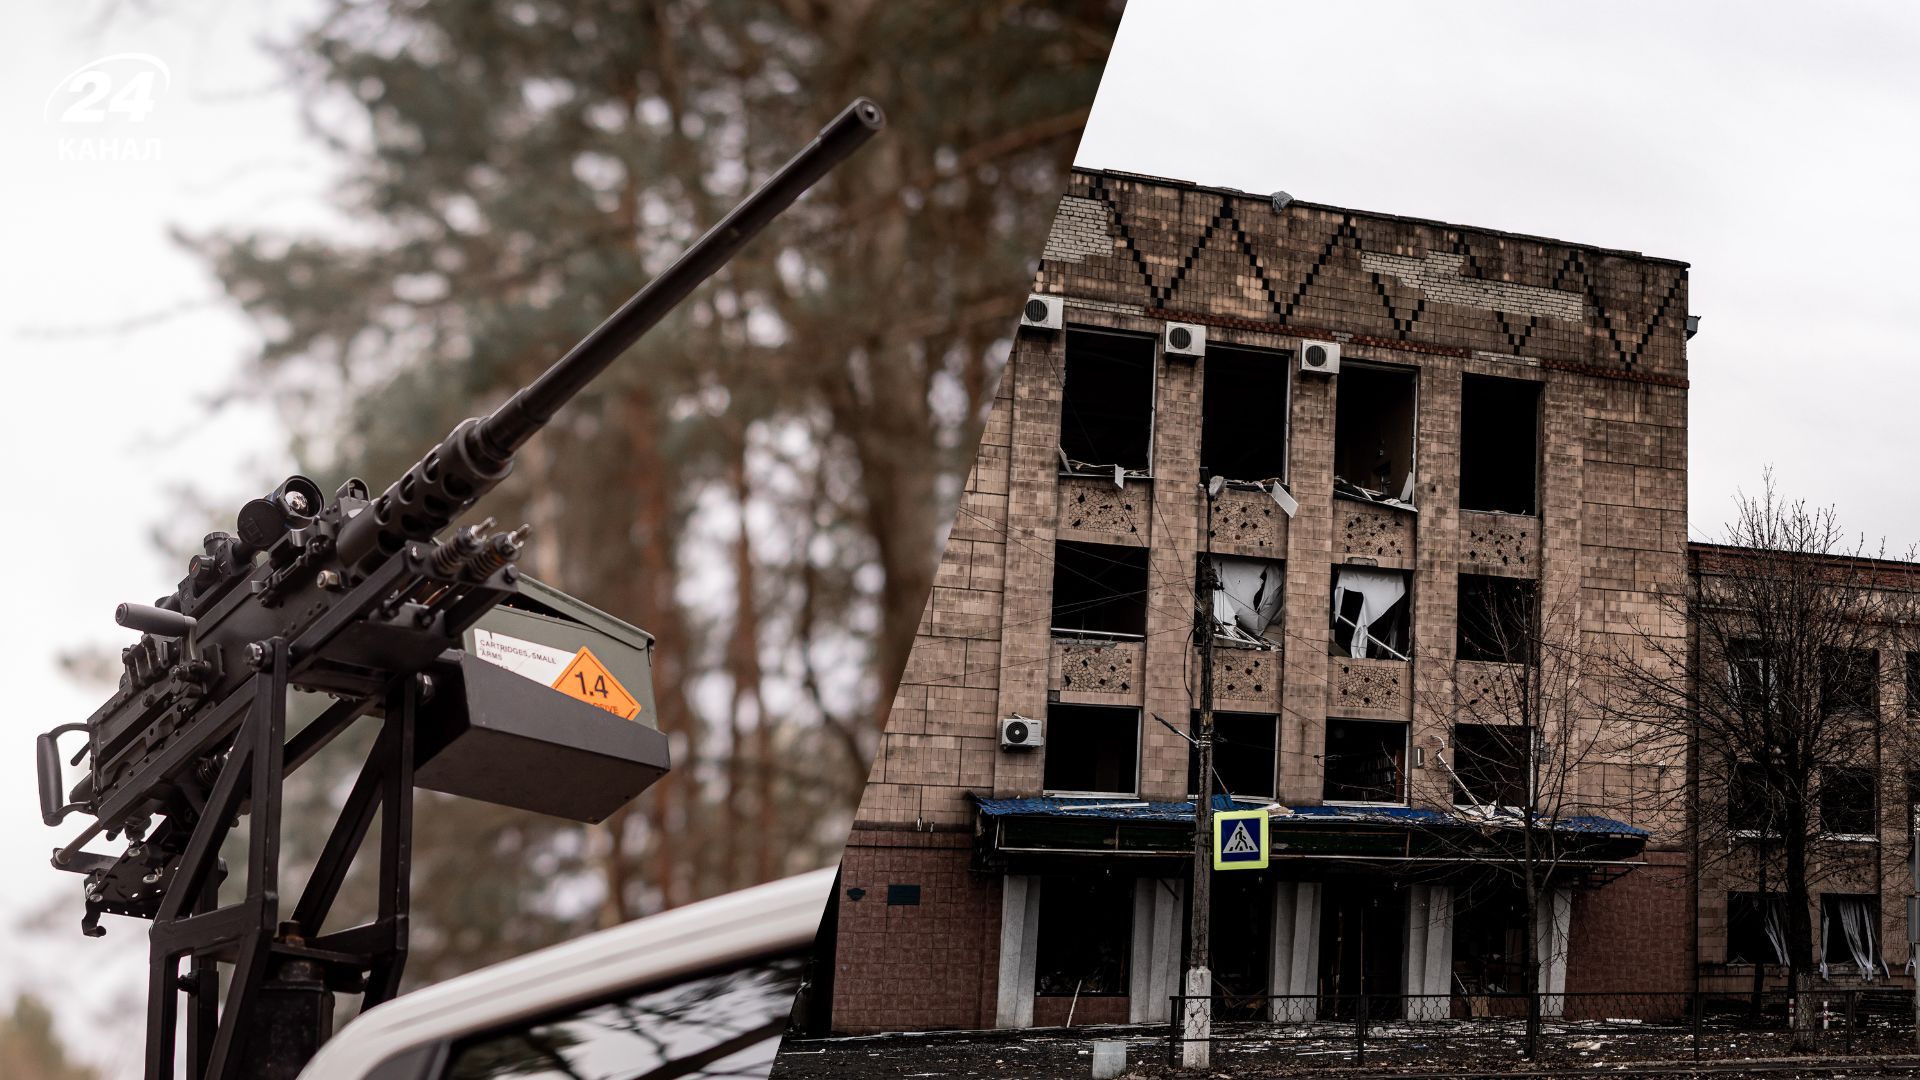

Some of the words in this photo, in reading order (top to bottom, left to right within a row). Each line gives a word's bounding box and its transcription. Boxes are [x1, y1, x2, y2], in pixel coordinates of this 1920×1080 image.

[482, 650, 502, 661] ARMS
[532, 652, 557, 664] SMALL
[575, 672, 608, 698] 1.4
